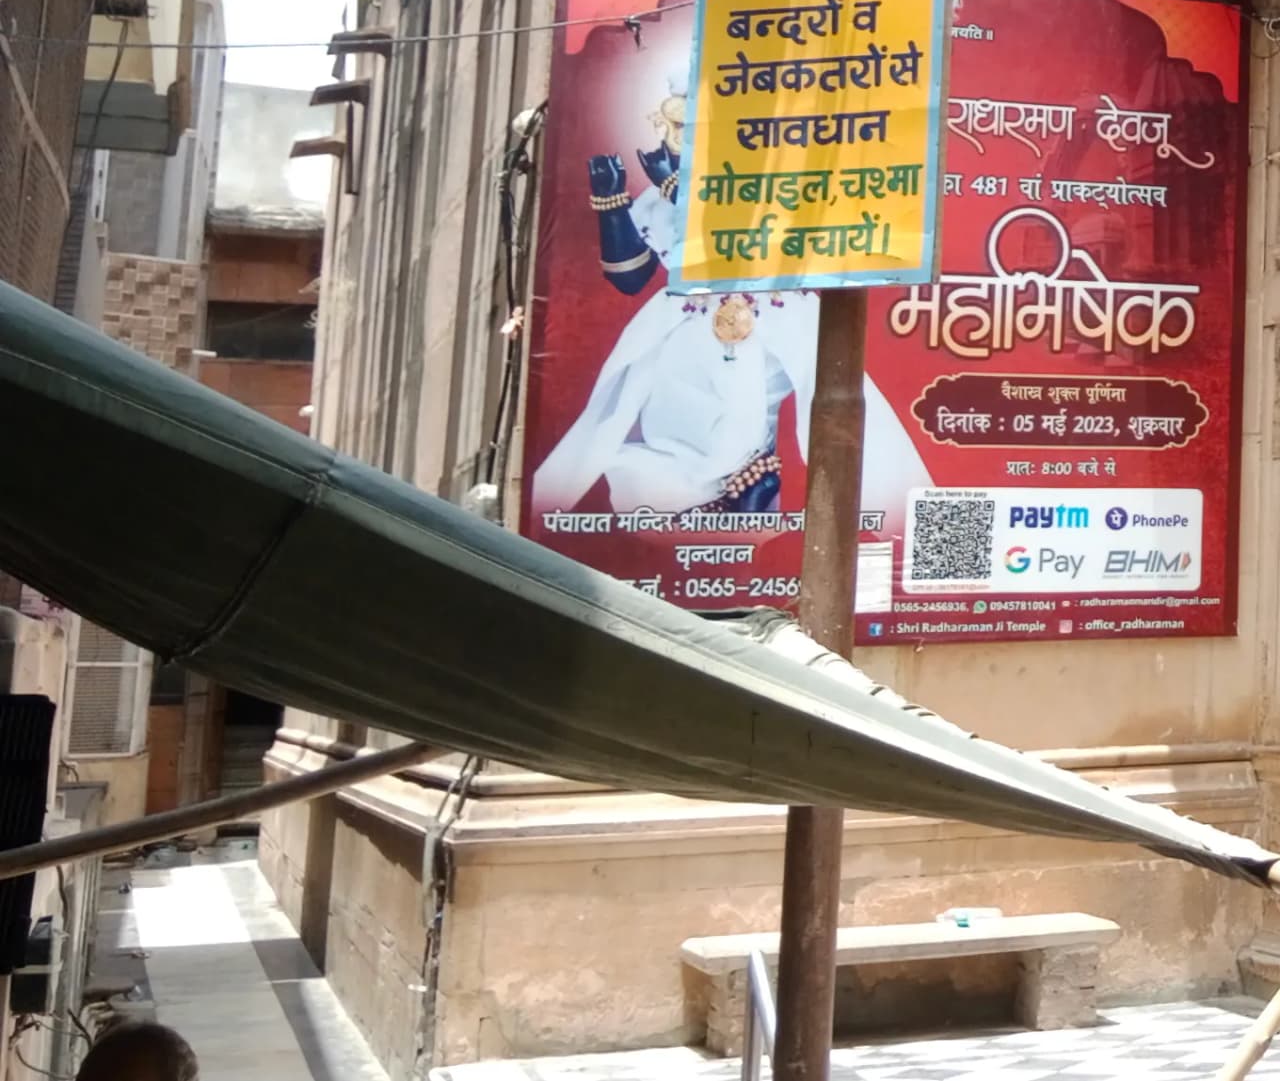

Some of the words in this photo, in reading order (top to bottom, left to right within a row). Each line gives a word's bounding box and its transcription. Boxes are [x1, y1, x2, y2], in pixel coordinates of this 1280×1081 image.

[852, 0, 882, 33] व
[714, 42, 888, 97] जेबकतरों
[889, 39, 924, 86] से
[736, 110, 891, 151] सावधान
[1094, 95, 1215, 169] देवजू
[970, 176, 1007, 197] 481
[1018, 173, 1042, 200] वां
[1051, 176, 1168, 210] प्राकट्योत्सव
[711, 214, 778, 262] पर्स
[888, 206, 1200, 359] महाभिषेक
[1001, 381, 1043, 401] वैशाख
[1048, 386, 1080, 405] शुक्ल
[1086, 383, 1127, 405] पूर्णिमा
[936, 405, 993, 434] दिनांक
[1013, 414, 1035, 432] 05
[1041, 408, 1067, 436] मई
[1072, 416, 1121, 437] 2023,
[1127, 416, 1186, 441] शुक्रवार
[1041, 462, 1072, 476] 8:00
[1077, 457, 1099, 477] बजे
[1104, 457, 1117, 476] से
[924, 490, 944, 498] Scan
[946, 490, 962, 498] here
[964, 490, 972, 498] to
[543, 508, 611, 533] पंचायत
[617, 506, 677, 533] मन्दिर
[1132, 513, 1189, 527] PhonePe
[675, 543, 756, 570] वृन्दावन
[1004, 546, 1031, 574] G
[1038, 548, 1085, 579] Pay
[1103, 550, 1183, 573] BHIM
[989, 601, 1057, 612] 09457810041
[896, 622, 920, 633] Shri
[921, 622, 993, 634] Radharaman
[995, 622, 1004, 633] Ji
[1006, 621, 1047, 633] Temple
[1084, 618, 1185, 632] office_radharaman
